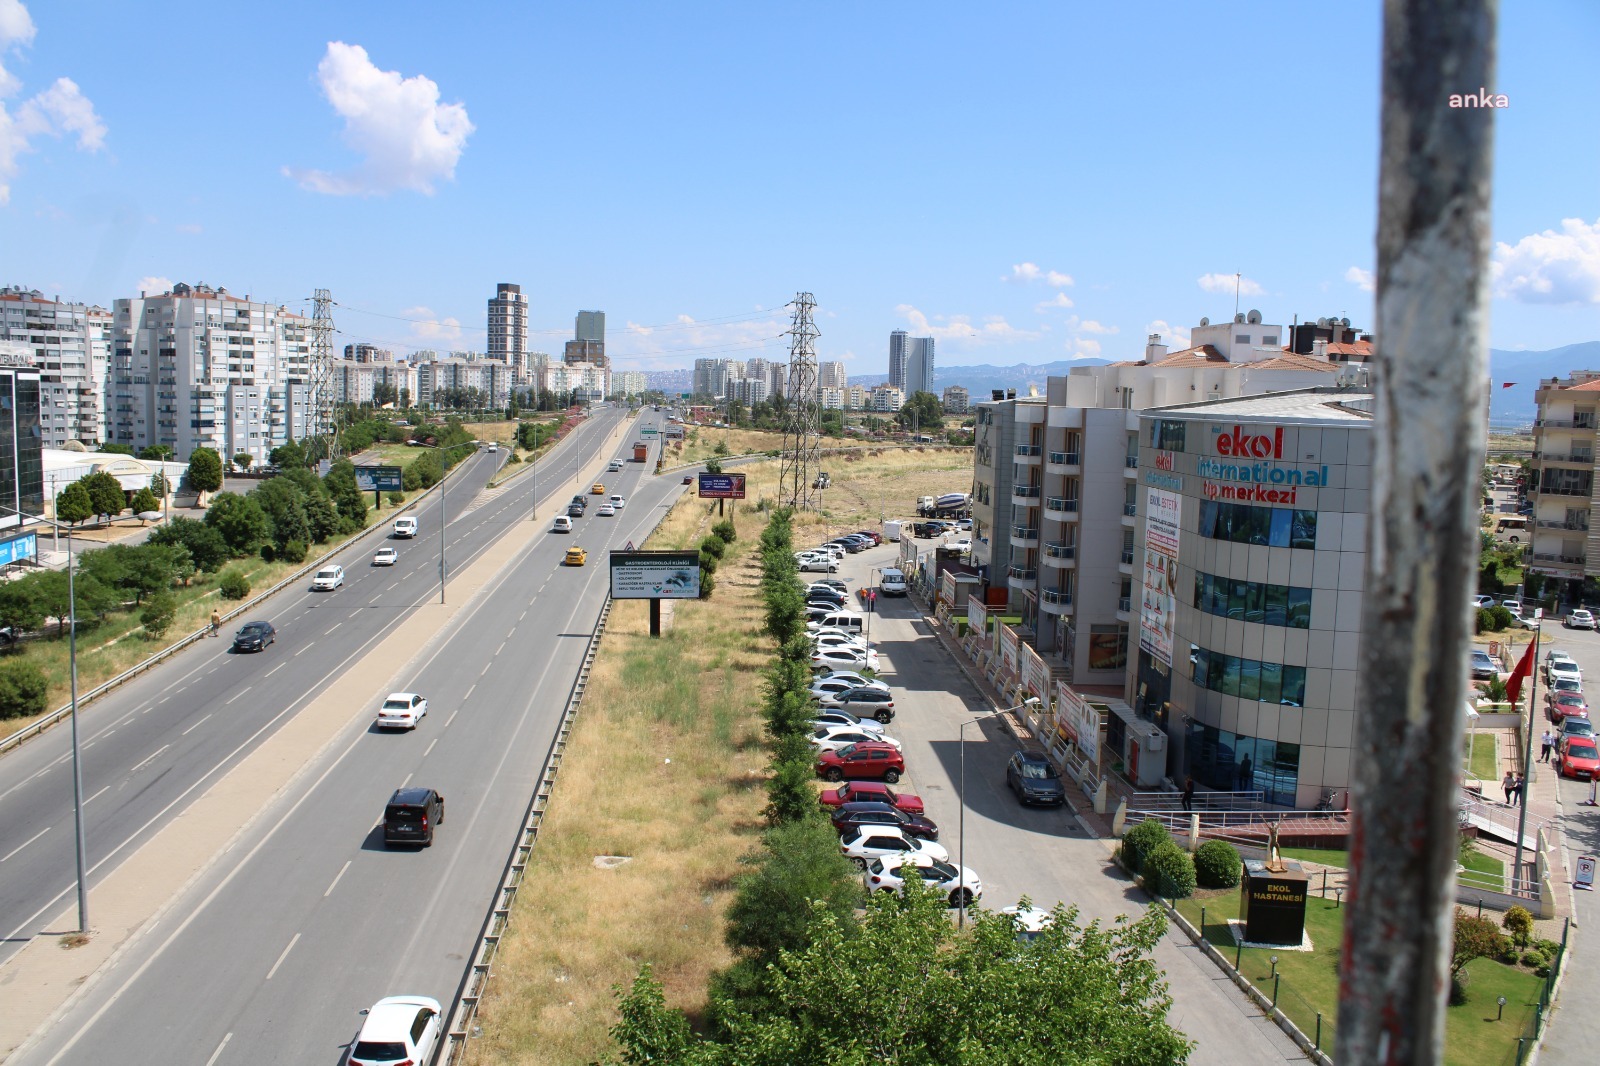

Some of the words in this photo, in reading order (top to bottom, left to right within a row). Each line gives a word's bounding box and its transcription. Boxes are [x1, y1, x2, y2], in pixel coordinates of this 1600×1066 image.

[1217, 425, 1284, 459] ekol
[1156, 450, 1174, 471] ekol
[1197, 456, 1328, 486] international
[1221, 483, 1296, 504] merkezi
[1253, 892, 1303, 902] HASTANESİ
[1267, 884, 1291, 893] EKOL
